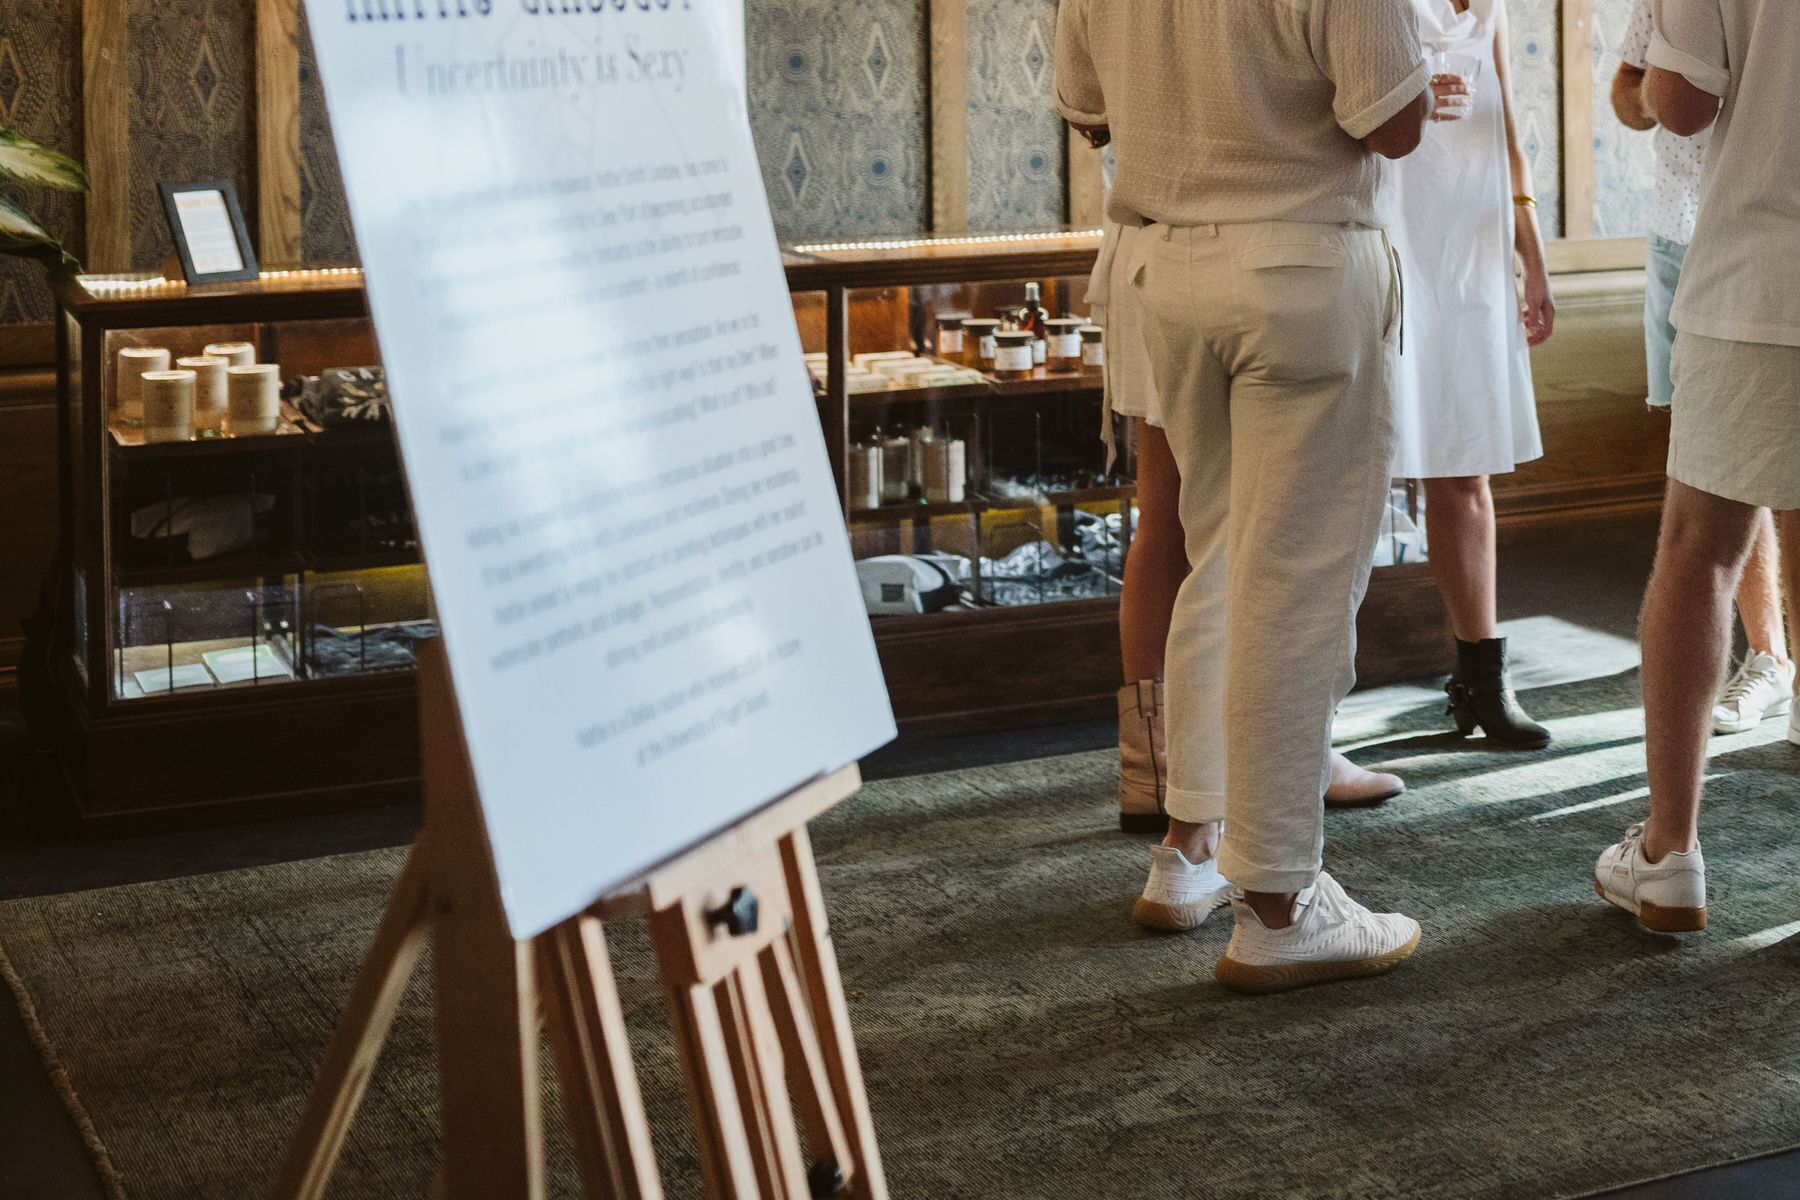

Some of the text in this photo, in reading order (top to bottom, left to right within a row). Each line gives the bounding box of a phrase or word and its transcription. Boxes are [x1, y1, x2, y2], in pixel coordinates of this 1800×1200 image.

[395, 33, 691, 102] Uncertainty is Sexy
